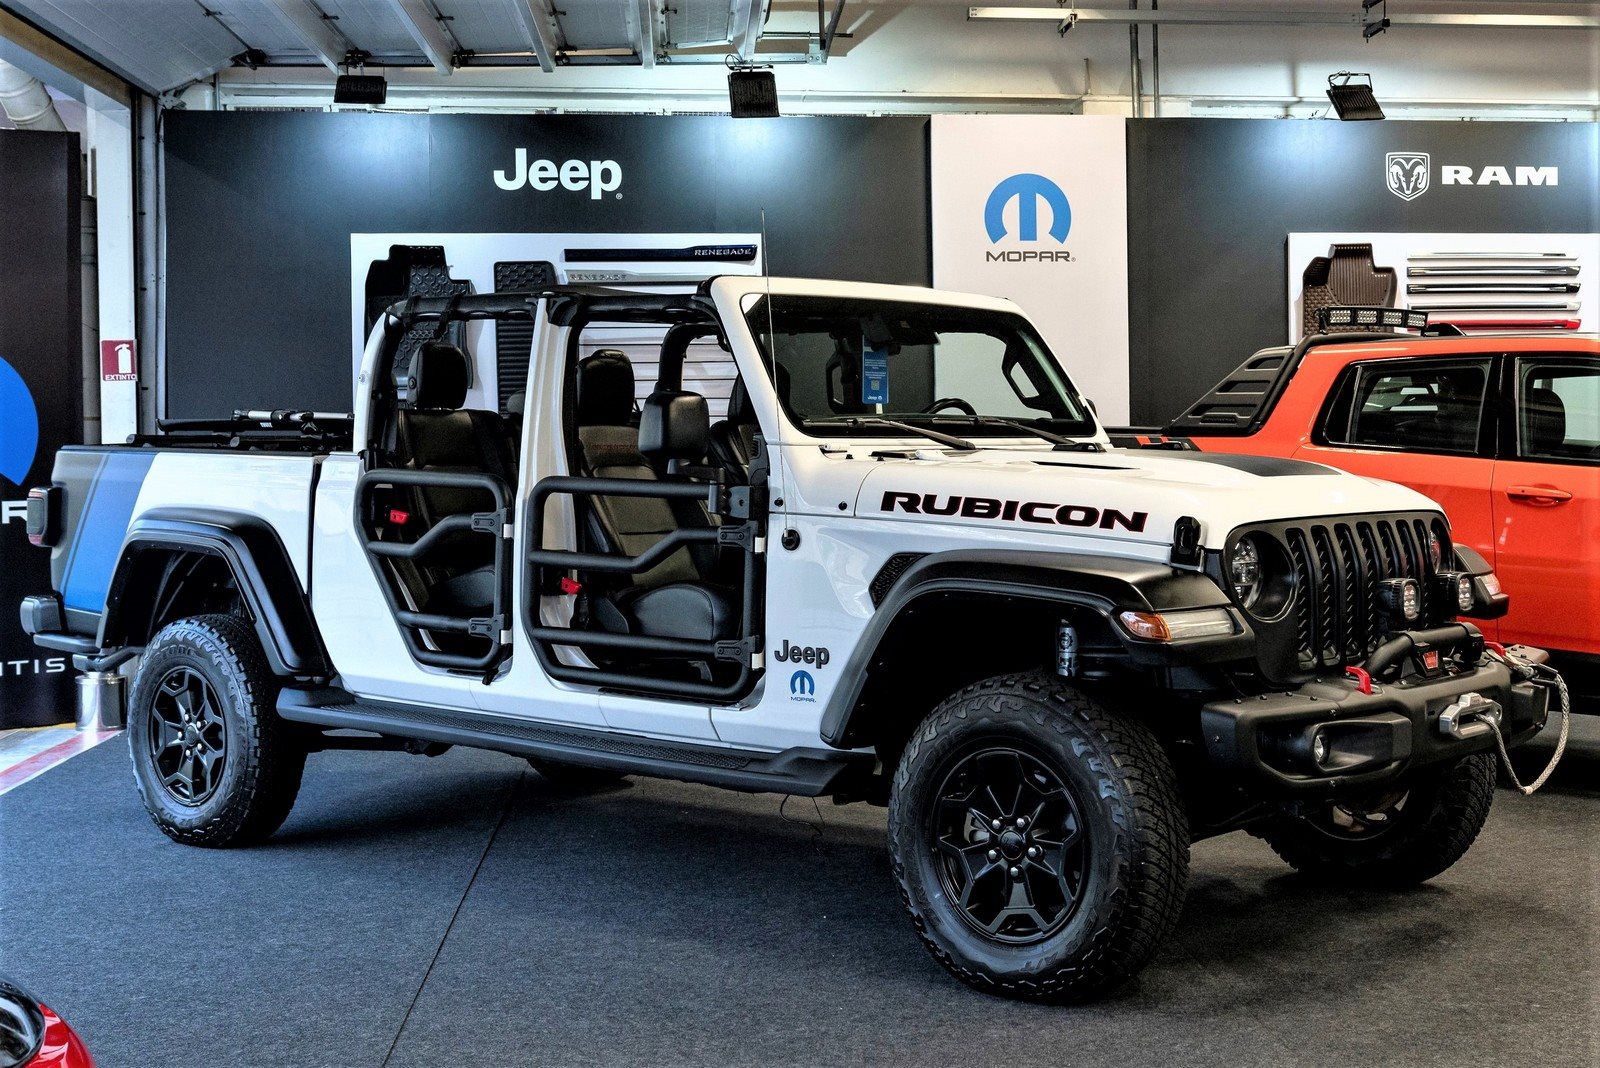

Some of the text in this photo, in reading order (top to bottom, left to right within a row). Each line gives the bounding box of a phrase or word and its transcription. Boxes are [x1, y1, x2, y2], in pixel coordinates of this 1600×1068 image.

[493, 148, 622, 200] Jeep
[1441, 165, 1559, 186] RAM
[694, 248, 752, 256] RENEGADE
[986, 251, 1070, 262] MOPAR
[880, 490, 1149, 533] RUBICON
[774, 639, 830, 669] Jeep
[0, 657, 66, 677] TIS
